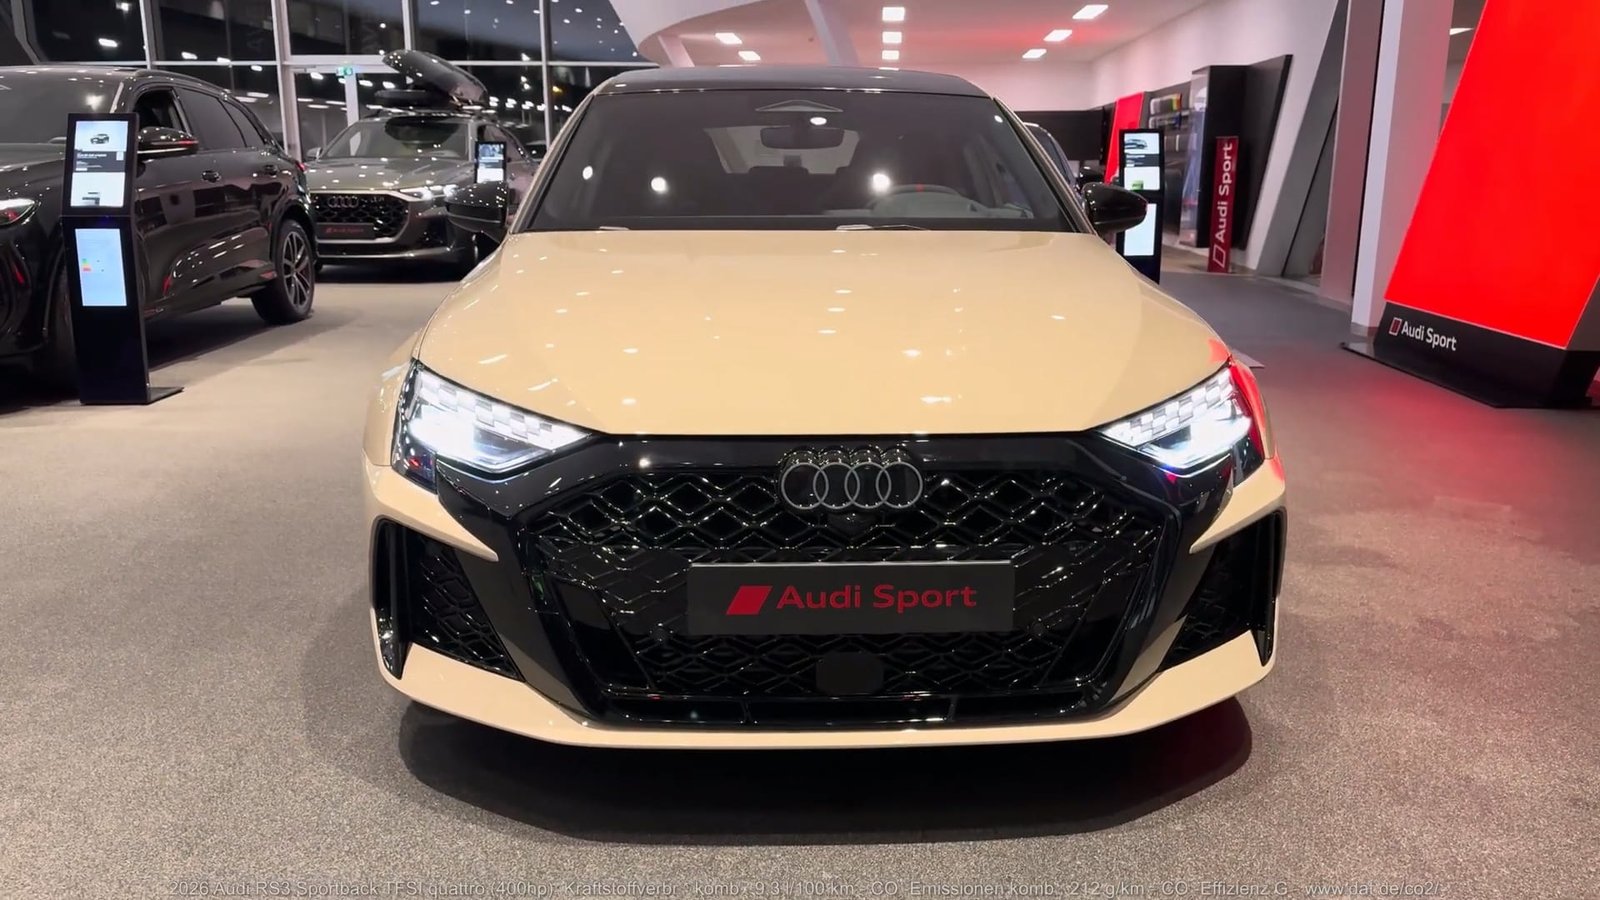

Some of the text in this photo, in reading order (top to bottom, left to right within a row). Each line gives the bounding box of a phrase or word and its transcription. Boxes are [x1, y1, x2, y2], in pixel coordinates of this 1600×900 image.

[1214, 142, 1234, 243] Audi Sport
[1401, 320, 1457, 351] Audi Sport
[776, 584, 977, 613] Audi Sport
